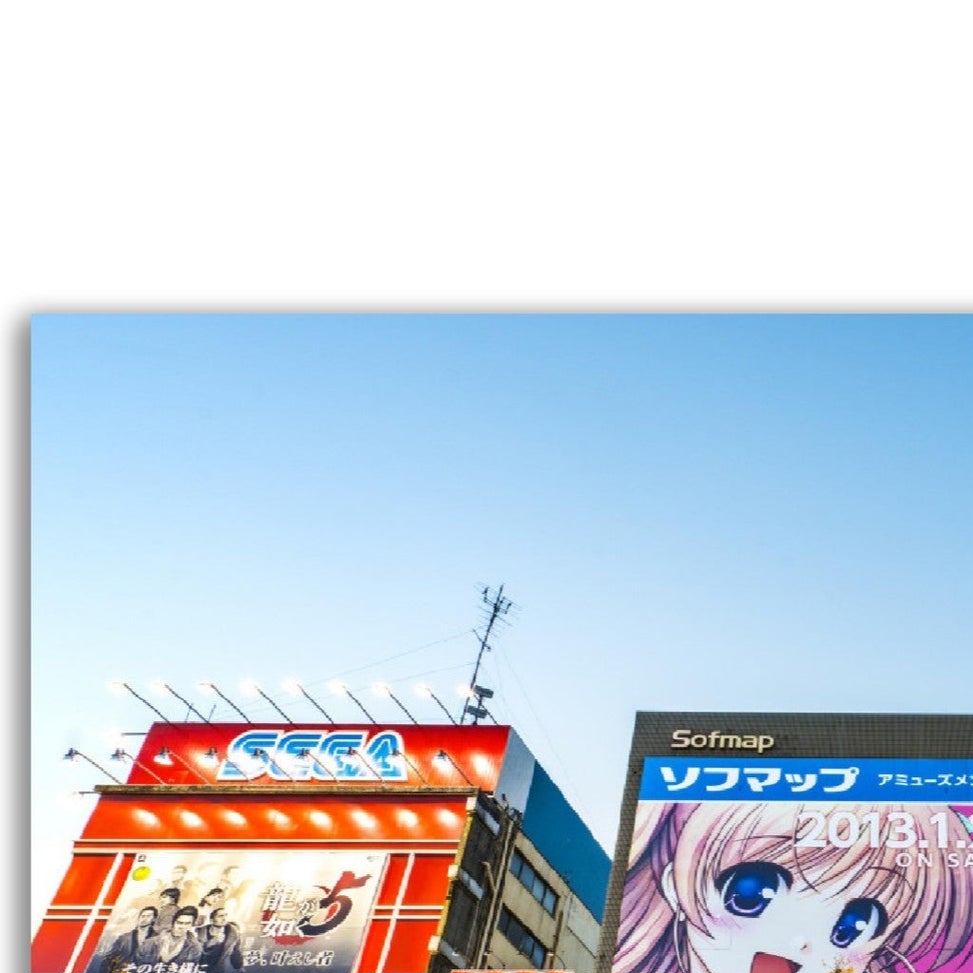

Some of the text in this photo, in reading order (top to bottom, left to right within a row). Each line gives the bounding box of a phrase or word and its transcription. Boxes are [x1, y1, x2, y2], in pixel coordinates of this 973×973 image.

[671, 730, 774, 752] Sofmap
[217, 730, 407, 781] SEGA
[660, 766, 859, 792] ソフマップ
[896, 853, 932, 868] ON
